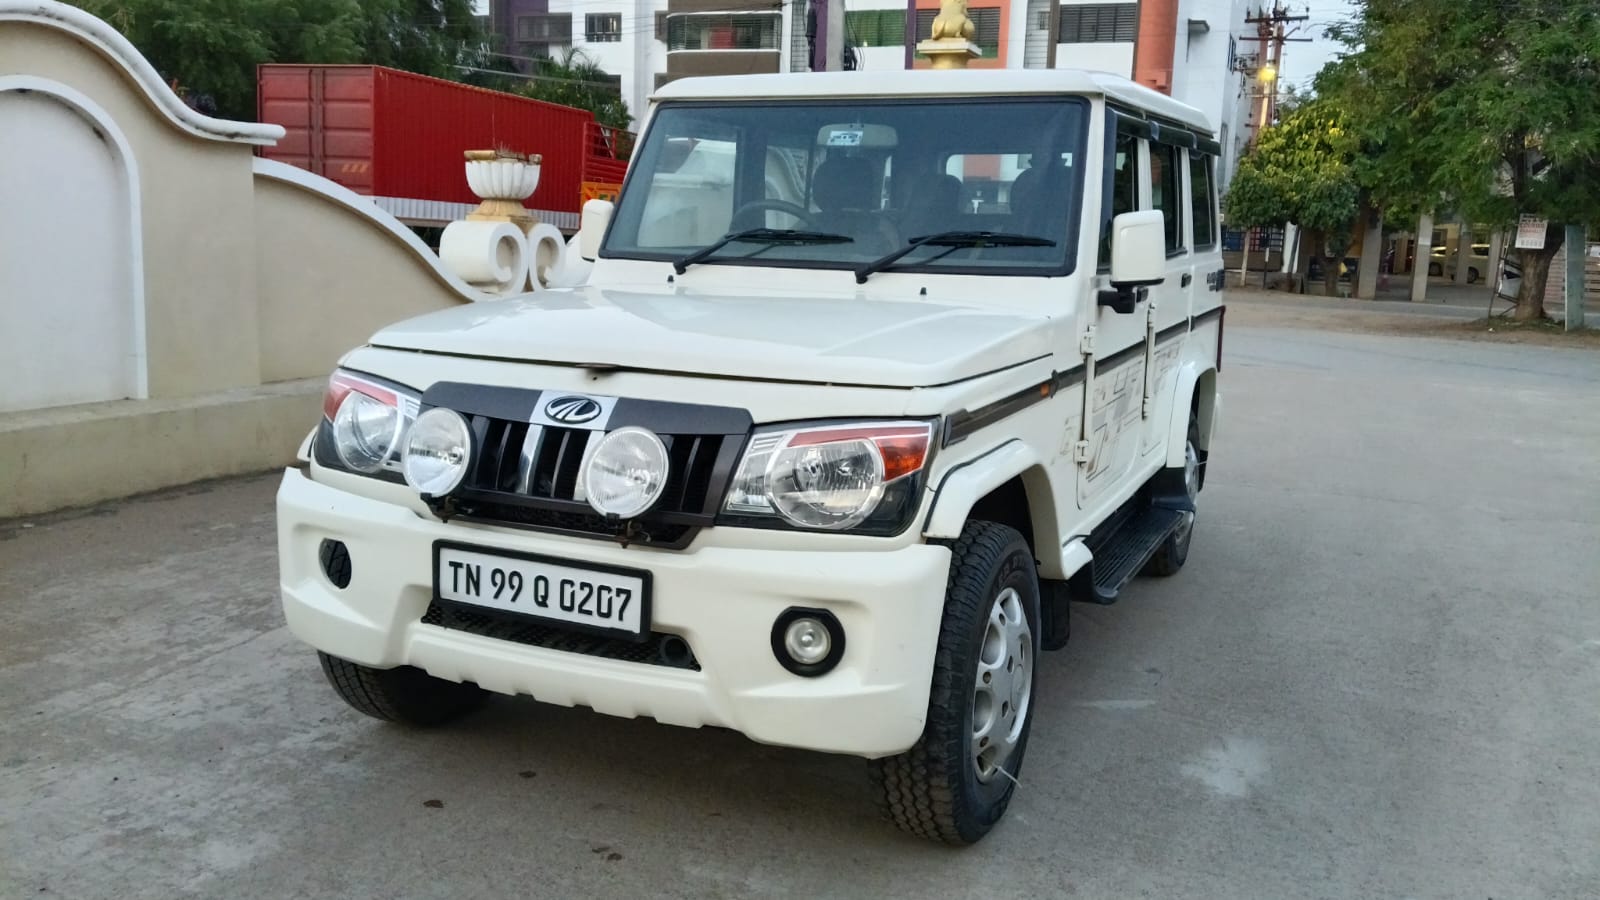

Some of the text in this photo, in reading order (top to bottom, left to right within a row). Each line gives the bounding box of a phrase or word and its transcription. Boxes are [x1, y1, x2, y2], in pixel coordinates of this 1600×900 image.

[448, 560, 632, 622] TN 99 Q 0207
